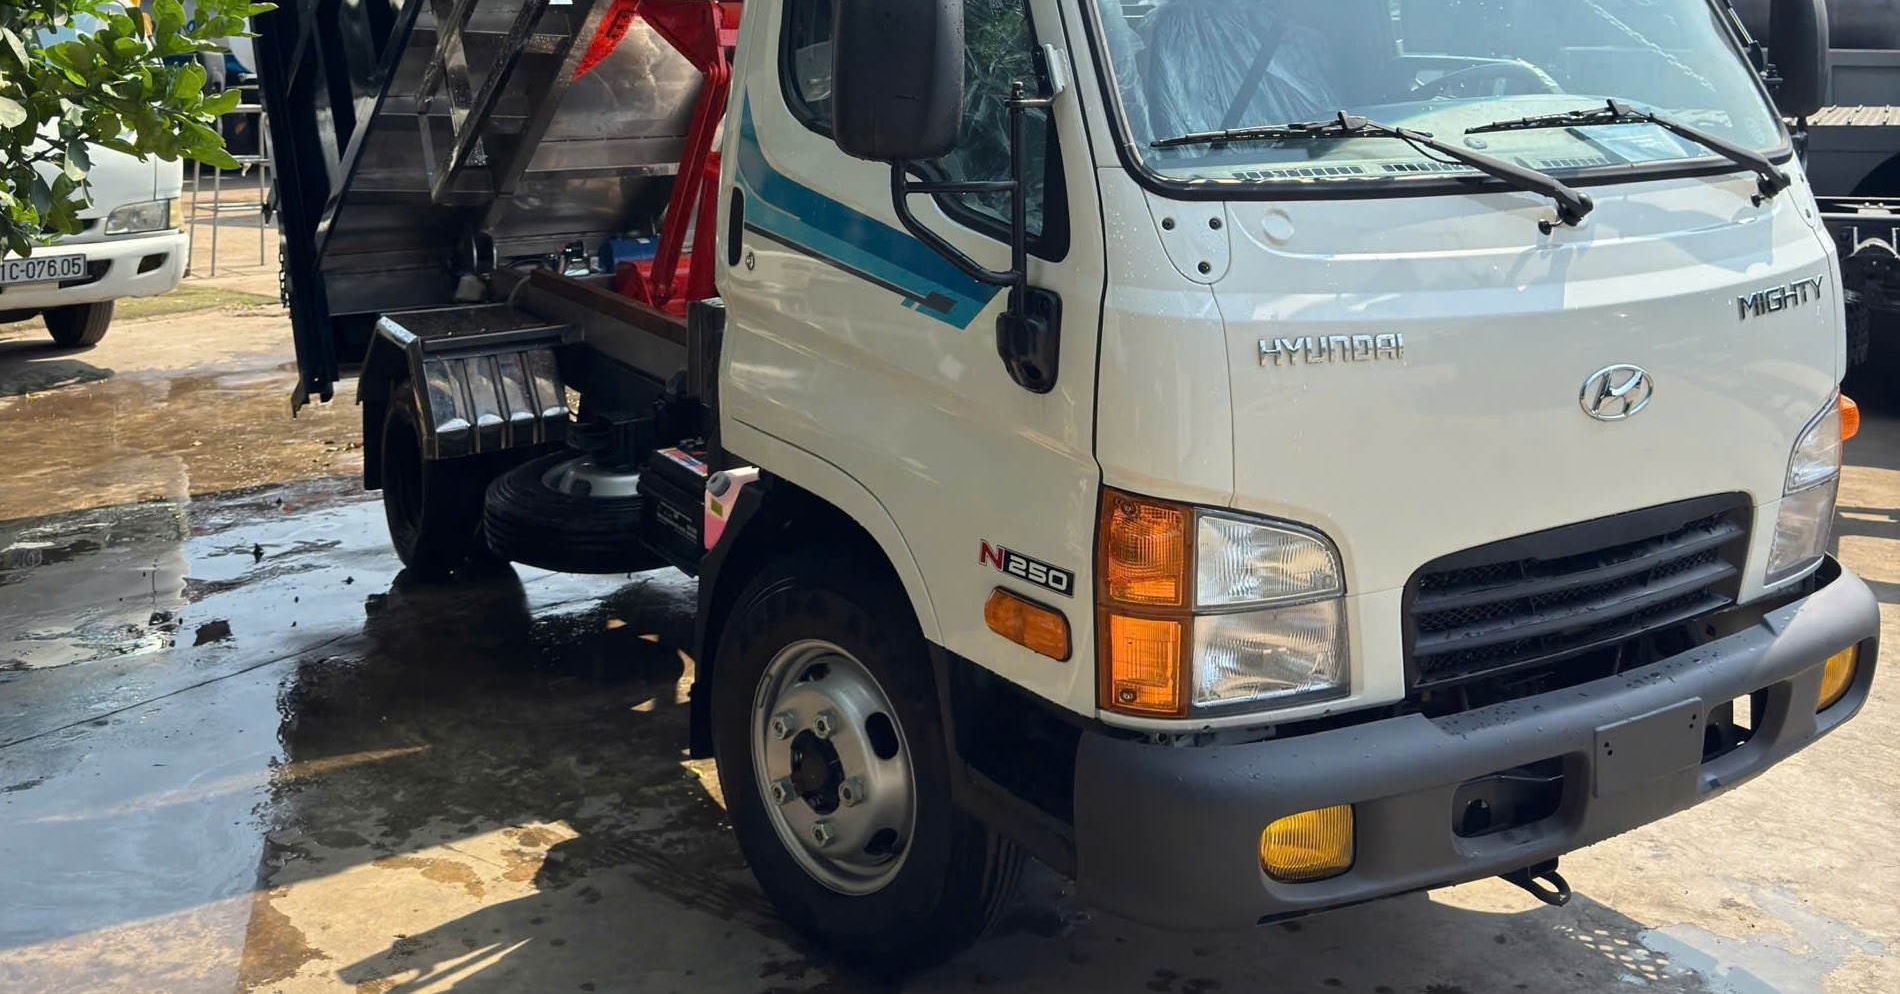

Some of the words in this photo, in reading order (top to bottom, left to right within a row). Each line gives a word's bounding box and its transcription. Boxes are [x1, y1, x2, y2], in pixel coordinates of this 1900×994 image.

[1737, 274, 1823, 321] MIGHTY
[1258, 333, 1404, 366] HYUNDAI
[979, 539, 1068, 591] N250
